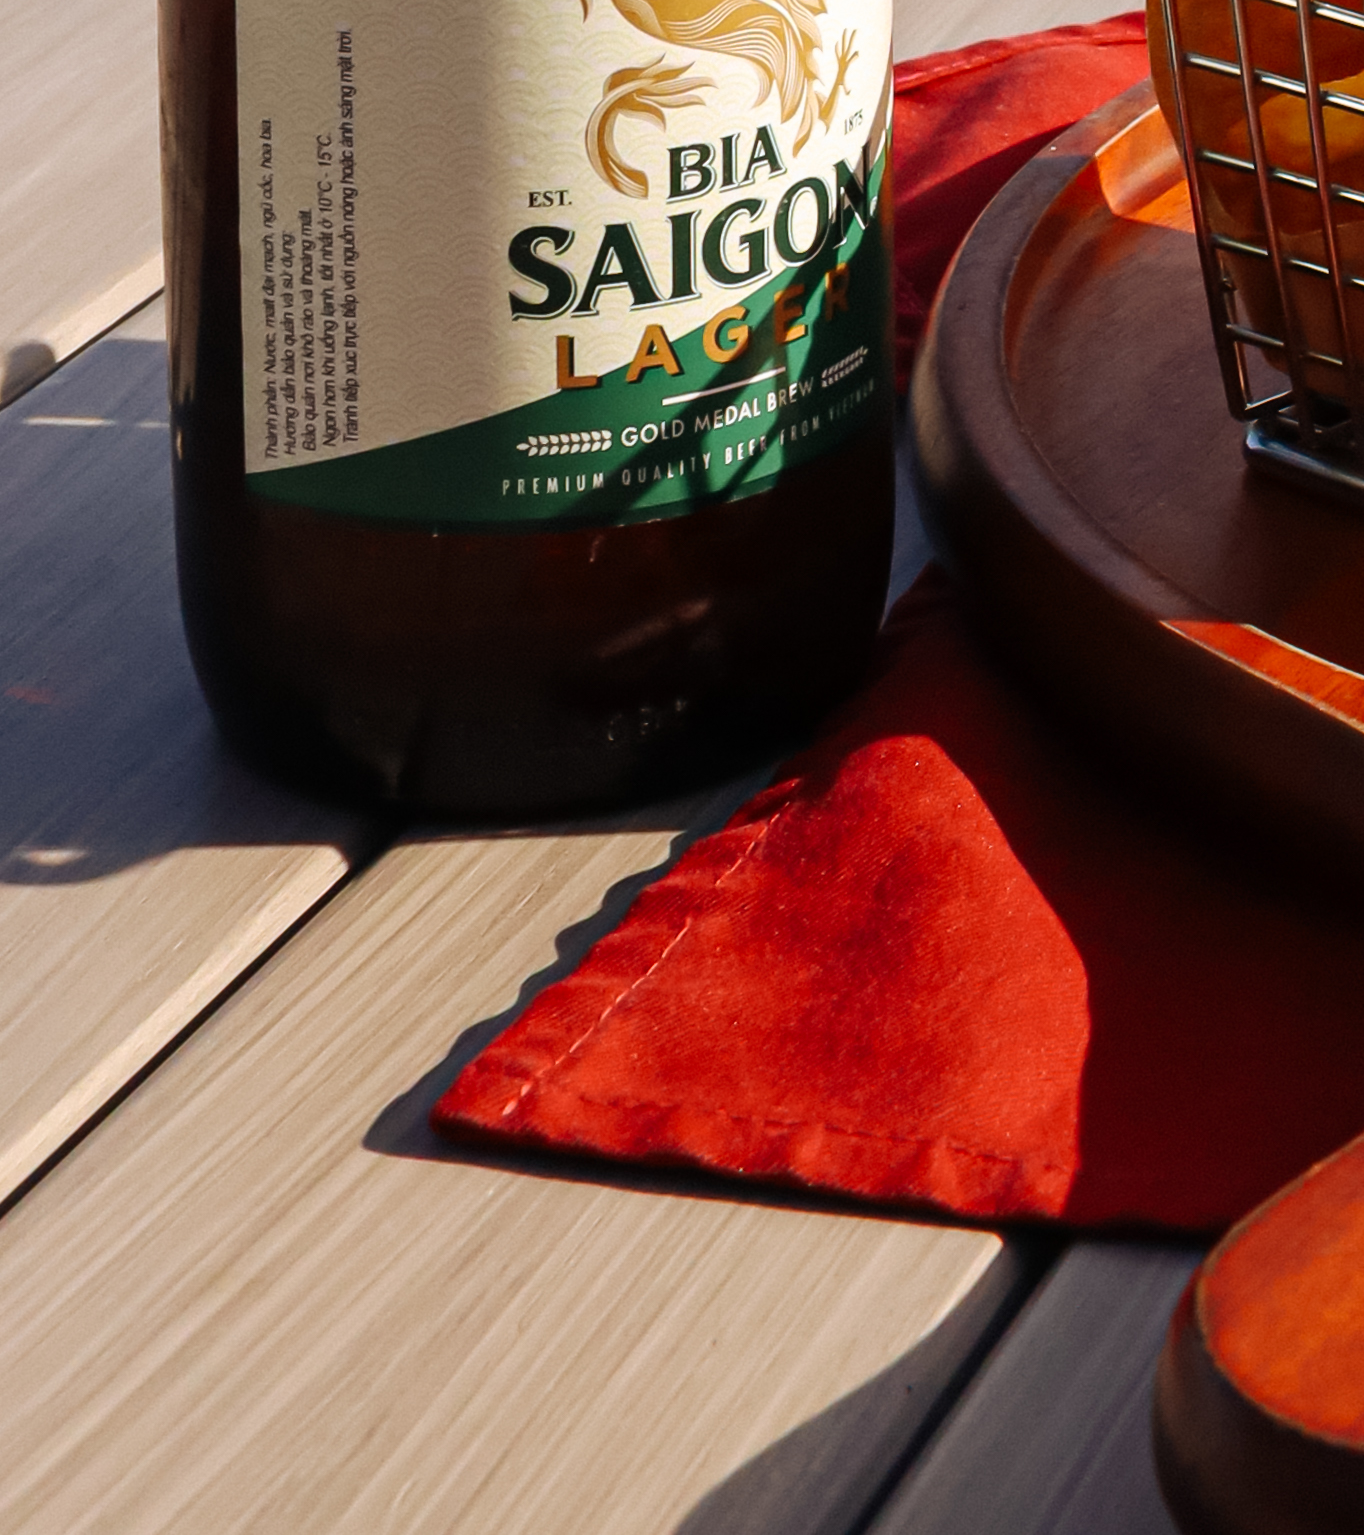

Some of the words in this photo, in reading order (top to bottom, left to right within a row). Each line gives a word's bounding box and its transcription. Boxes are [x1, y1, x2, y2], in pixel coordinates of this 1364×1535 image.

[844, 109, 865, 136] 1875
[665, 123, 787, 204] BIA
[527, 189, 573, 208] EST.
[507, 141, 872, 322] SAIGON
[281, 293, 293, 307] và
[303, 290, 313, 305] và
[555, 262, 851, 389] LAGER
[323, 410, 340, 446] Ngon
[620, 417, 686, 449] GOLD
[693, 396, 761, 433] MEDAL
[767, 376, 815, 414] BREW
[501, 472, 605, 496] PREMIUM
[621, 452, 712, 487] QUALITY
[724, 437, 769, 466] BEER
[779, 416, 821, 447] FROM
